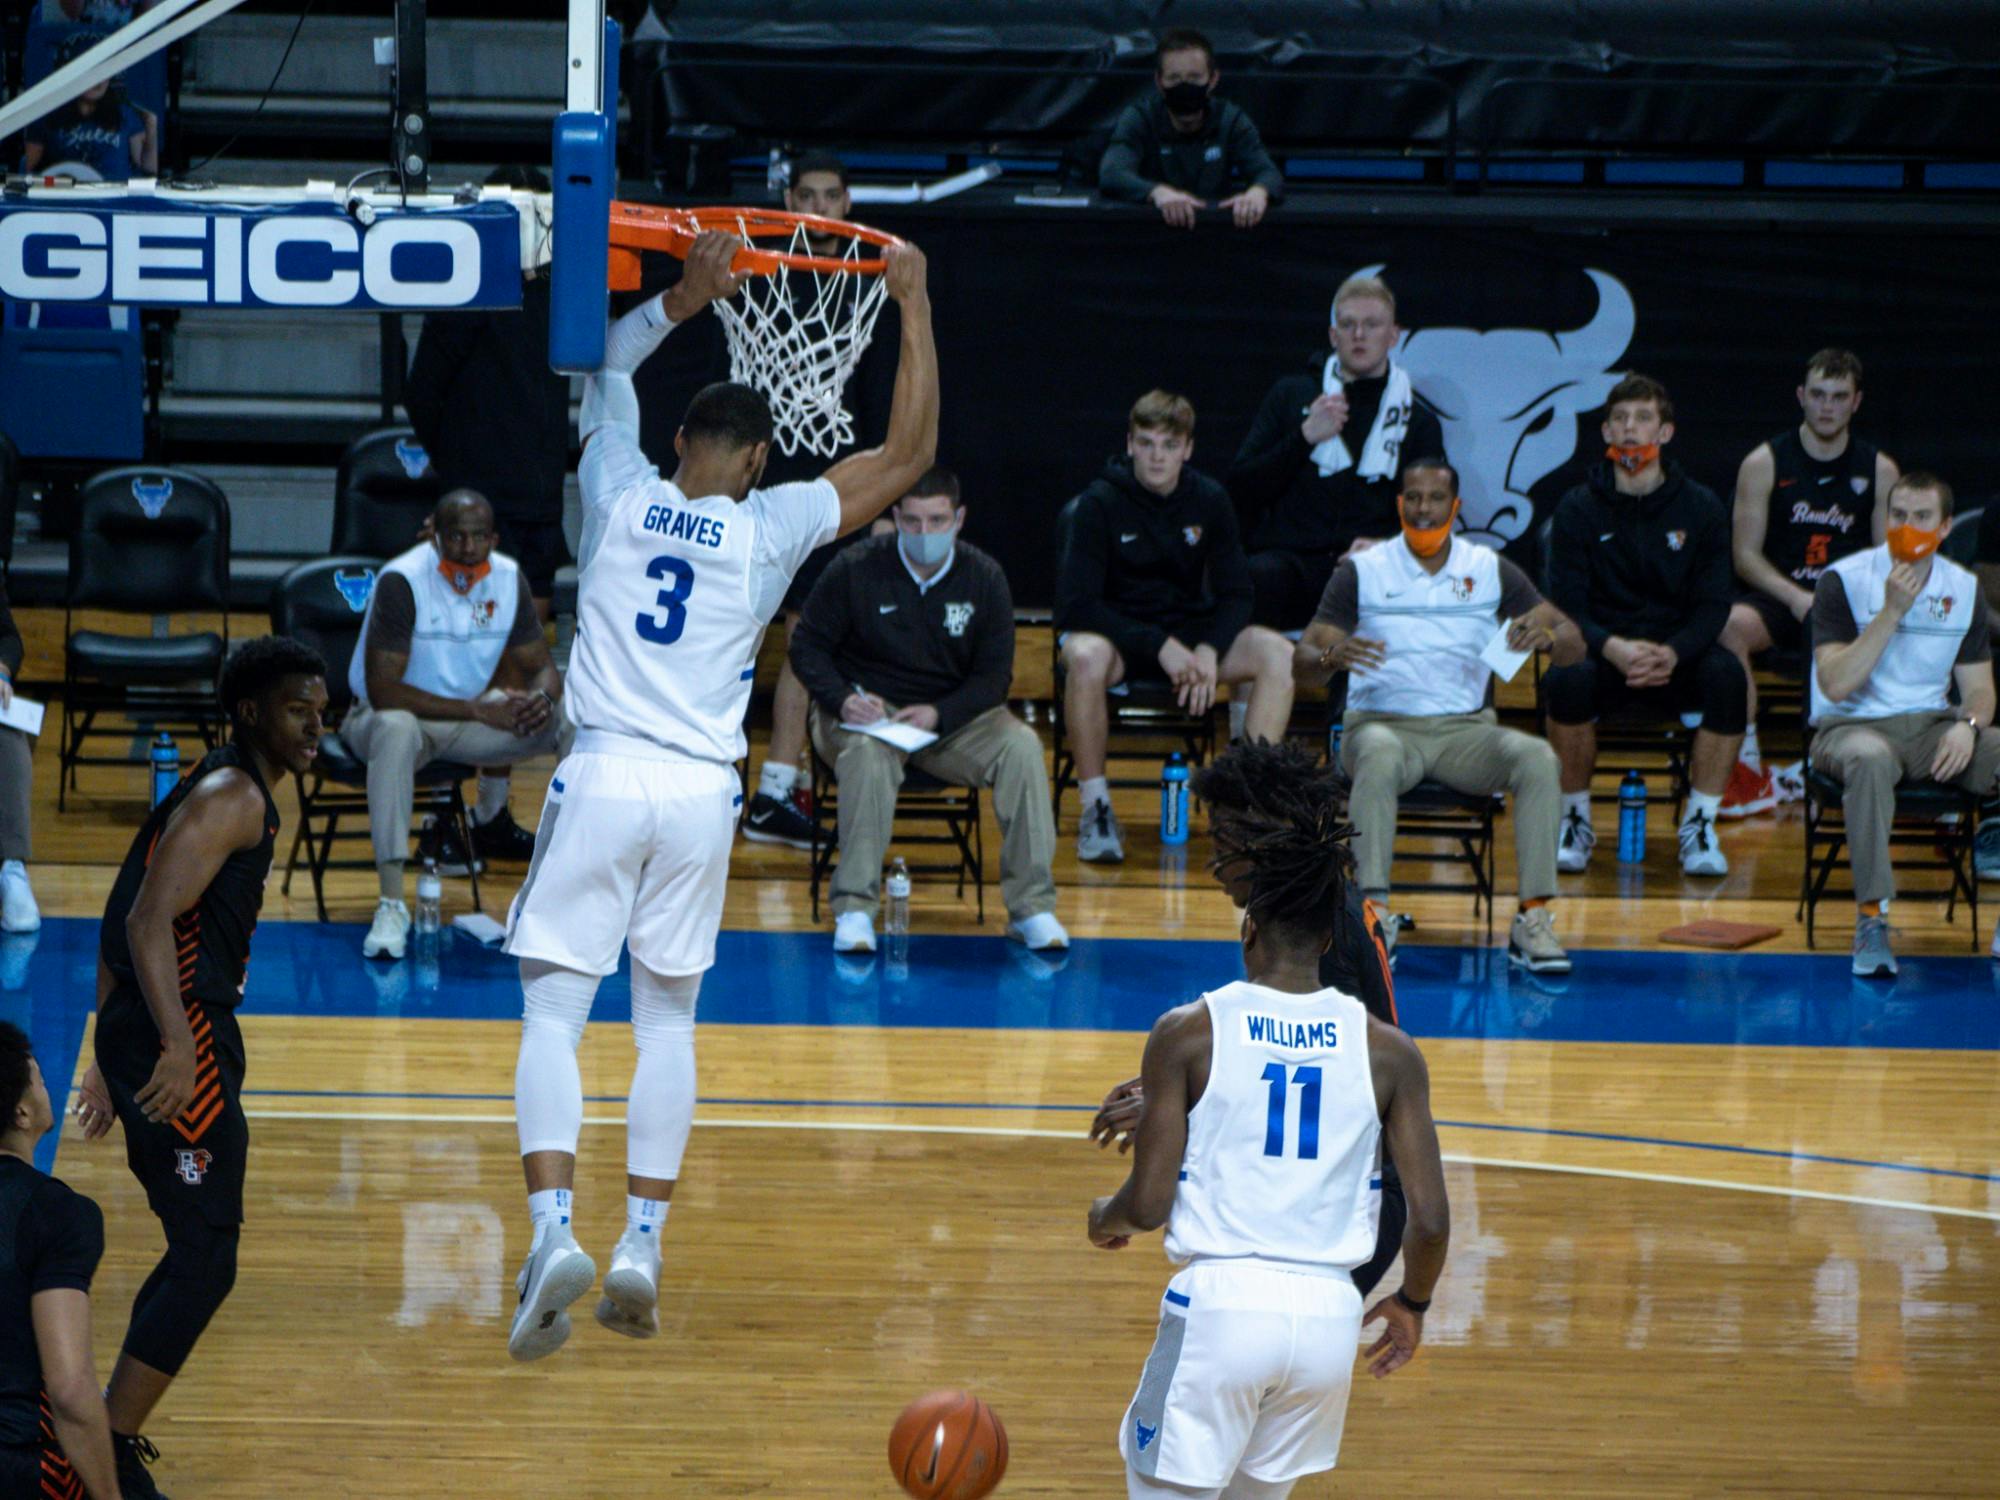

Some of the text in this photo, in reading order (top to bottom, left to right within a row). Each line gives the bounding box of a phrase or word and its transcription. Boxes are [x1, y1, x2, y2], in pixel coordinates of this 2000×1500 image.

[0, 212, 481, 306] GEICO
[643, 504, 724, 548] GRAVES
[635, 555, 695, 645] 3
[1247, 1015, 1337, 1049] WILLIAMS
[1260, 1062, 1322, 1160] 11
